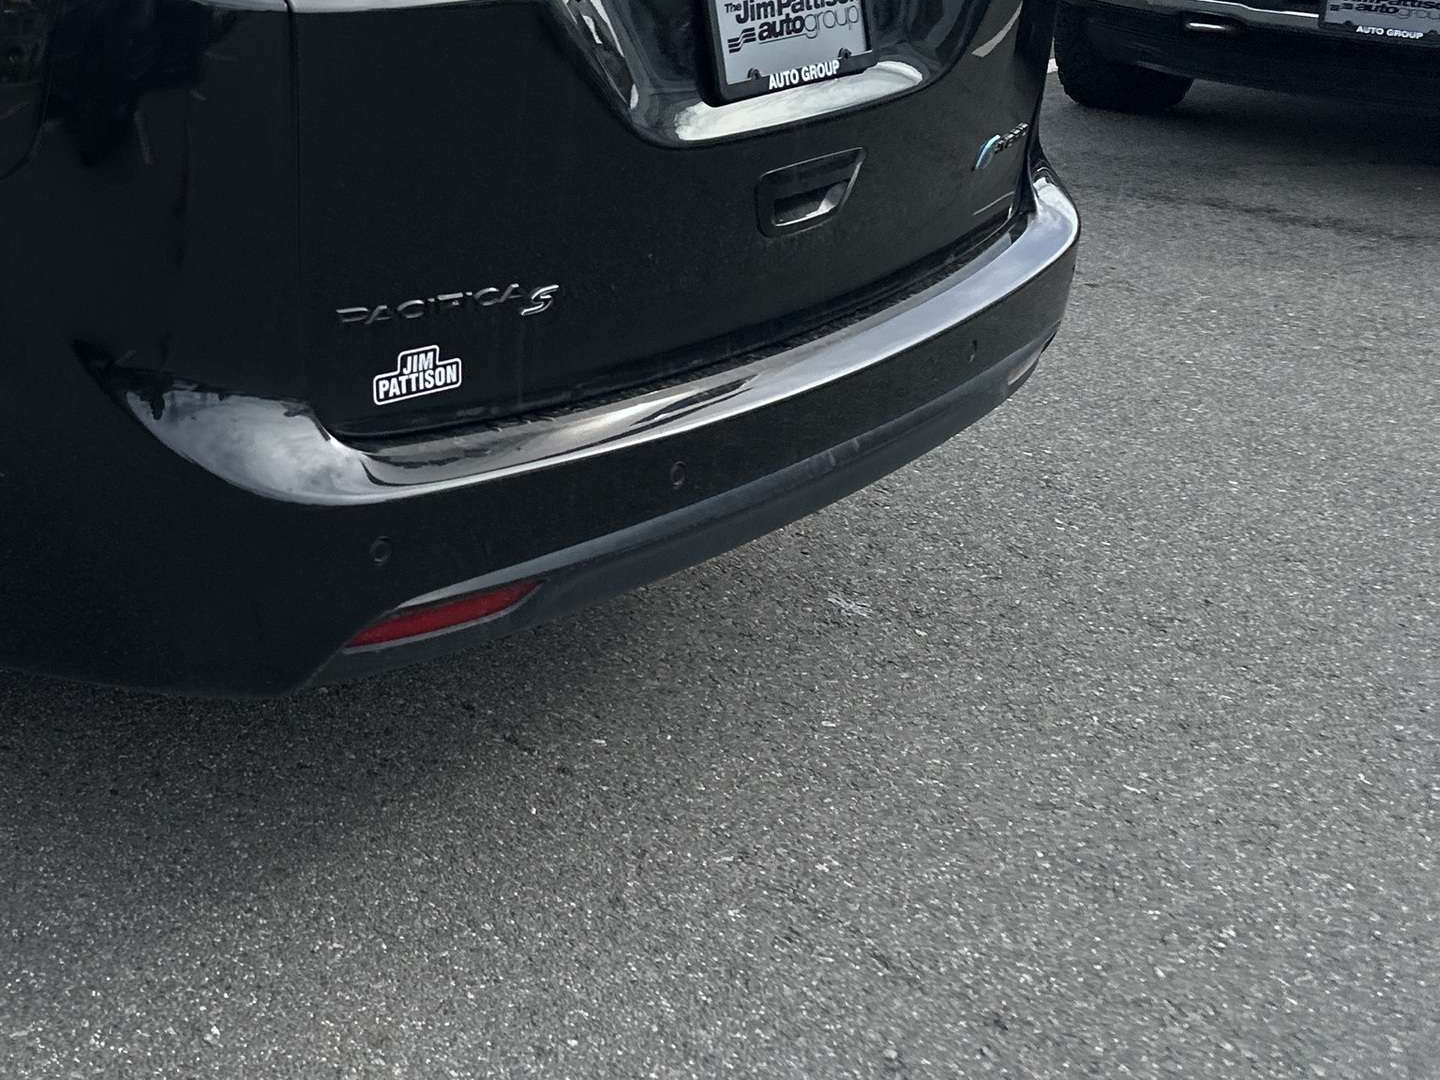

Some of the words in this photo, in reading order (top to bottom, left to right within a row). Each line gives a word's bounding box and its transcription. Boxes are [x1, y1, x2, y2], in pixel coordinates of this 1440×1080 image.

[724, 0, 742, 14] The
[1356, 26, 1384, 36] AUTO
[1386, 29, 1424, 39] GROUP
[768, 70, 800, 90] AUTO
[801, 59, 841, 82] GROUP
[520, 284, 559, 316] S
[403, 351, 434, 375] JIM
[378, 364, 458, 400] PATTISON
